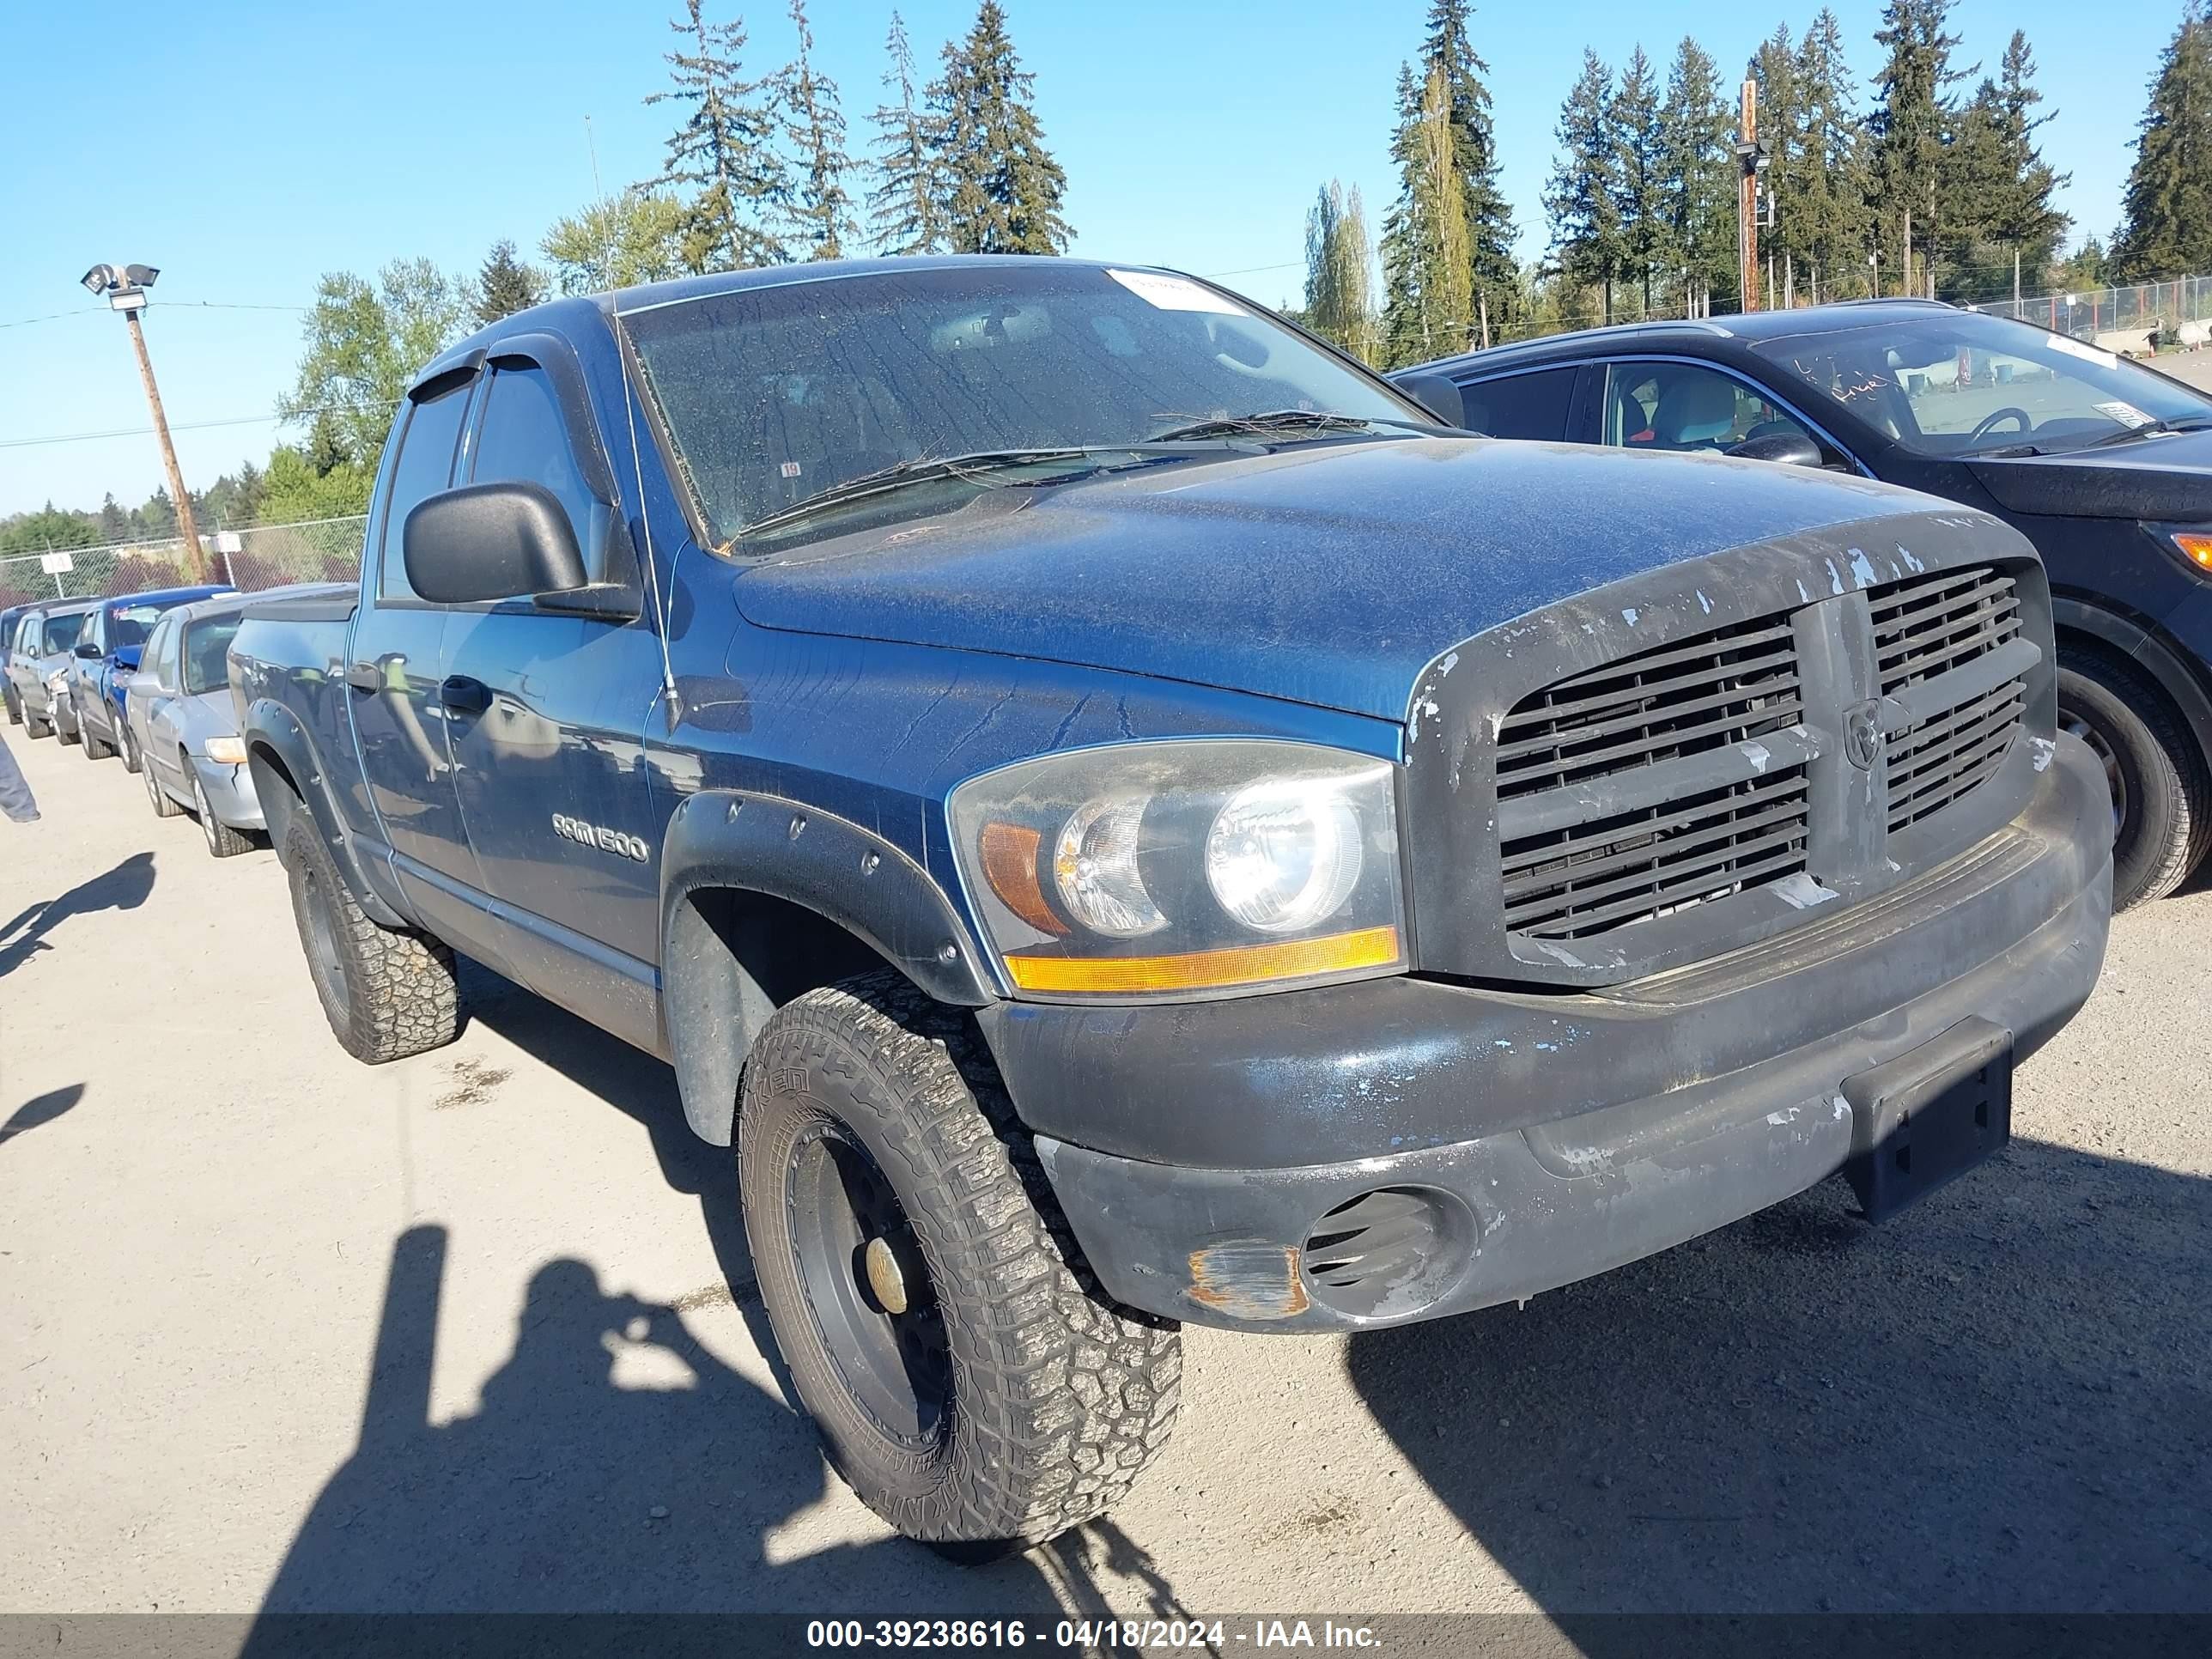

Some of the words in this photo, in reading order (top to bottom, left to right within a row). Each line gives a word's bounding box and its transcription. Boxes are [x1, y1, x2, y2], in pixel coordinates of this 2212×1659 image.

[784, 464, 798, 476] 19
[551, 812, 596, 848] RAM
[595, 826, 648, 863] 1500
